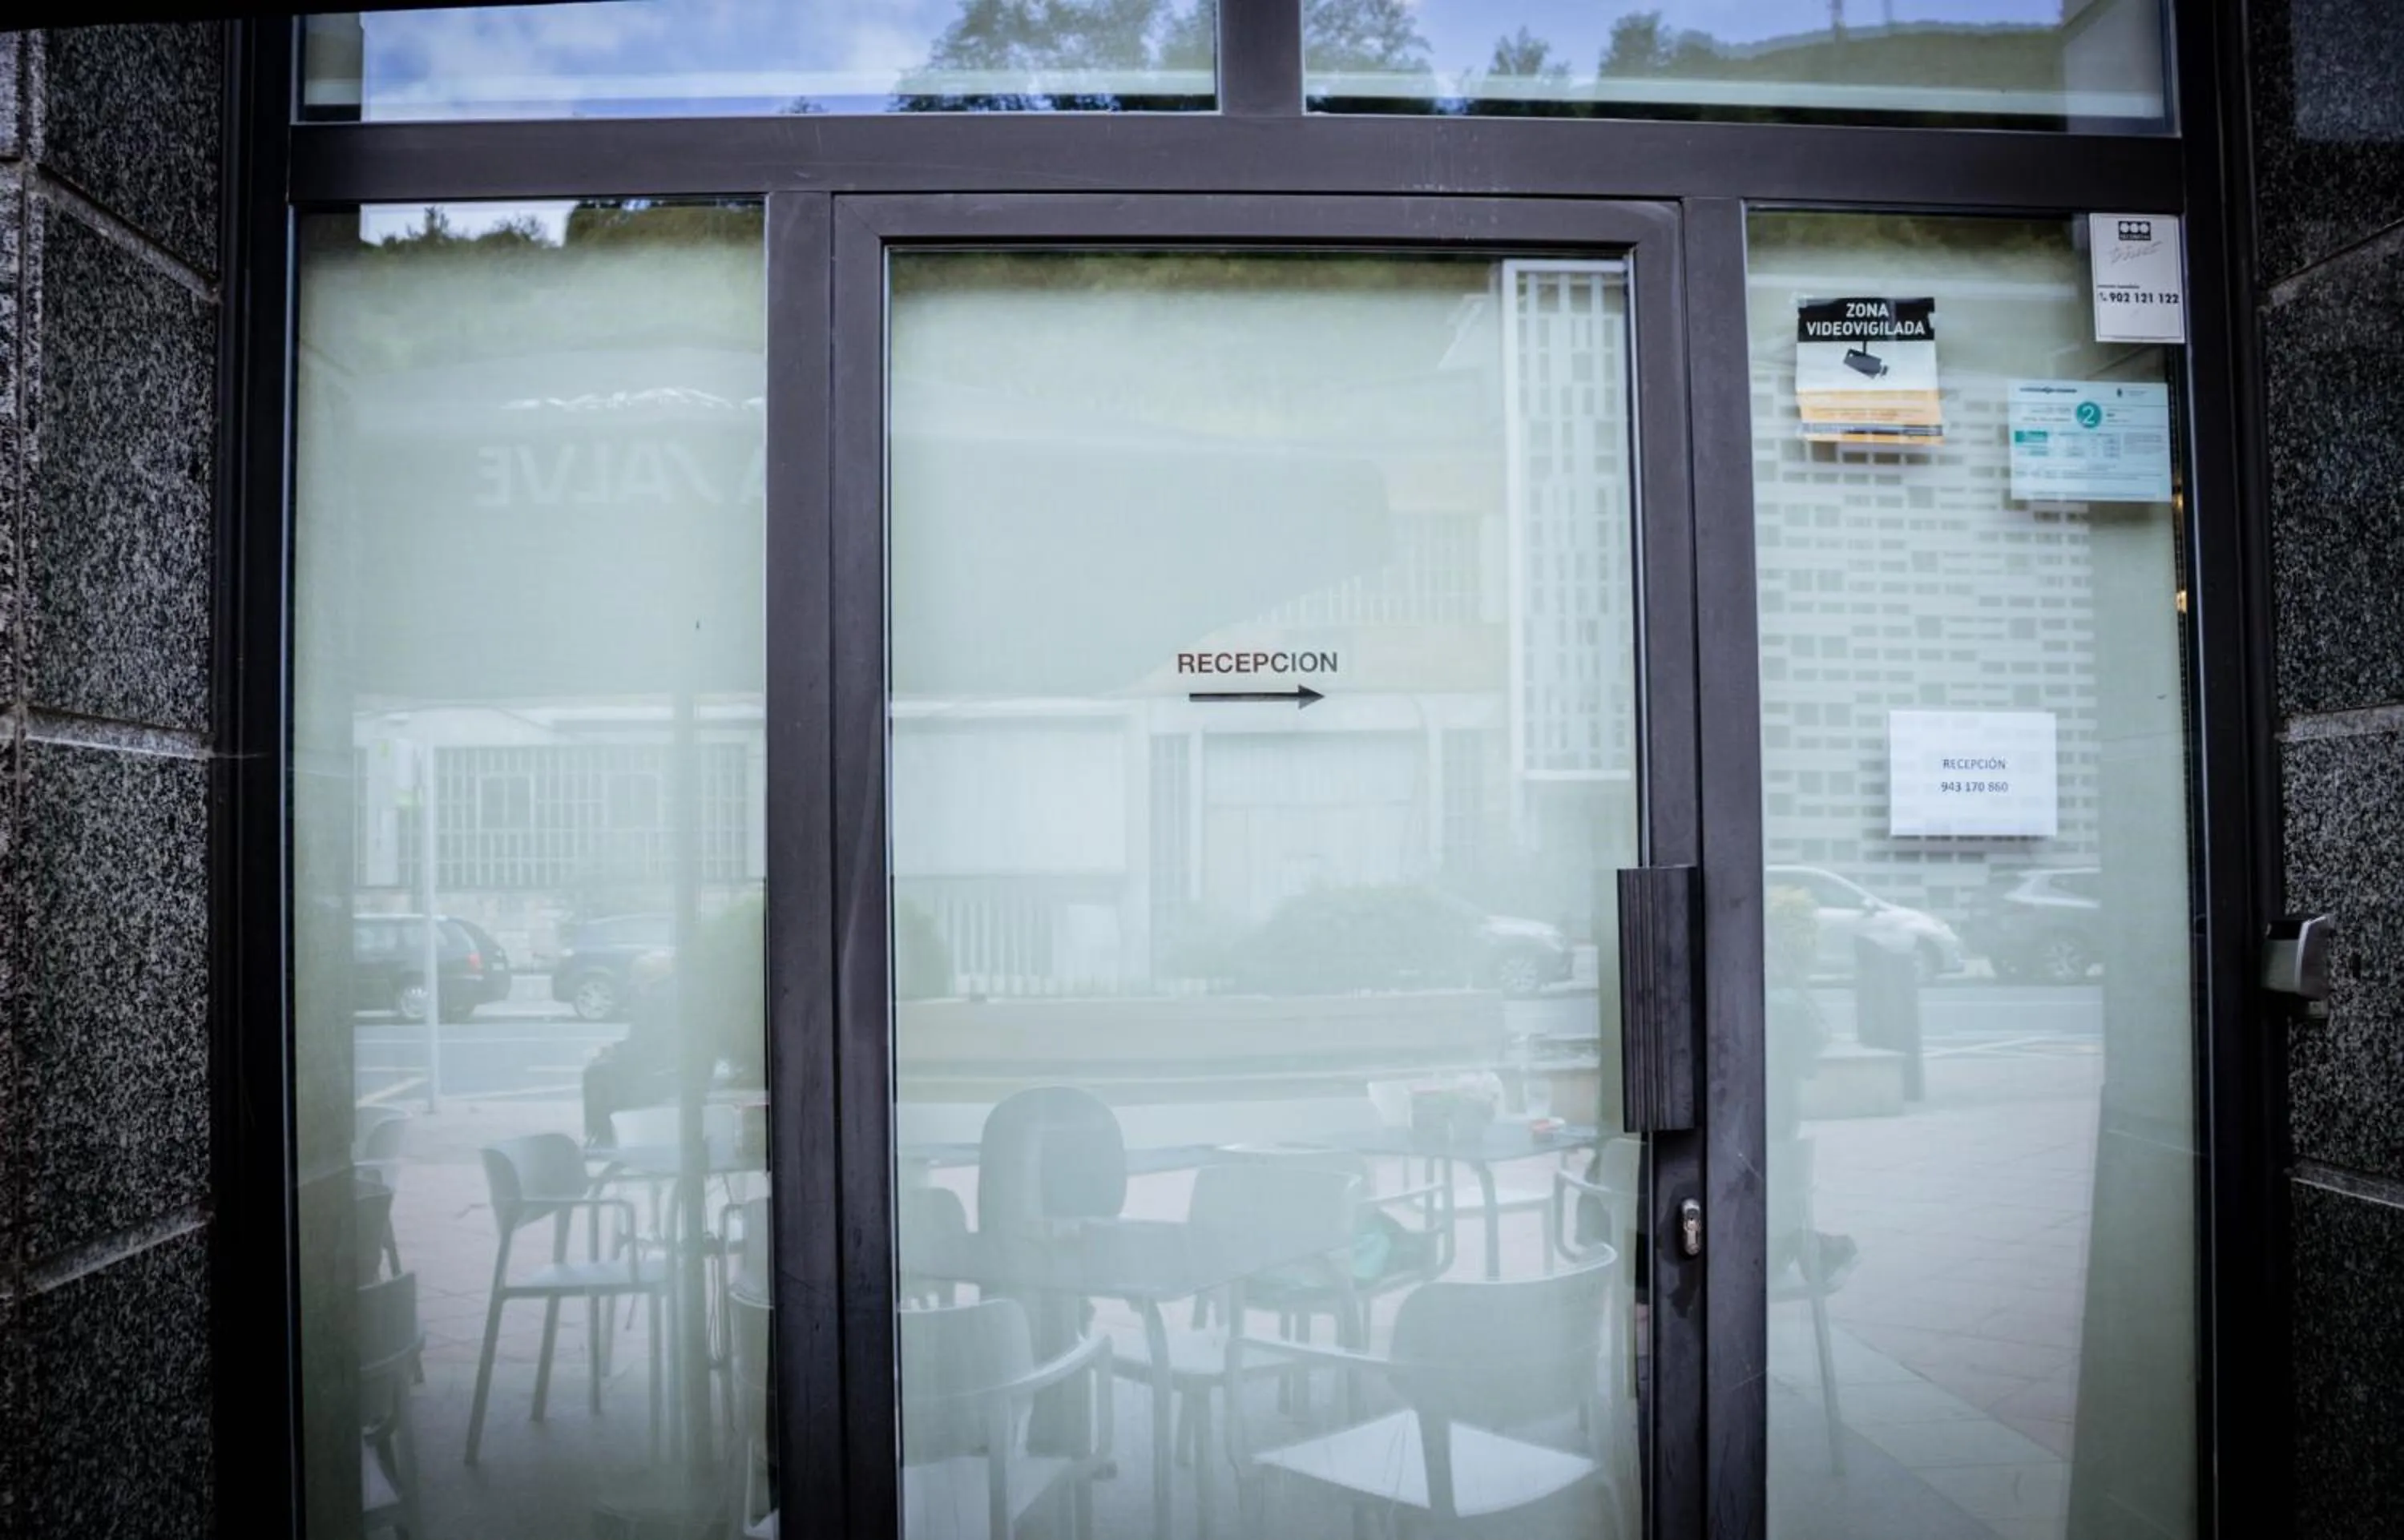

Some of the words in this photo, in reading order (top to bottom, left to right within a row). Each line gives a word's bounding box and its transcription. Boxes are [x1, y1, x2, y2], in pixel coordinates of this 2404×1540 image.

[2109, 292, 2130, 303] 902
[2159, 293, 2179, 304] 122
[1845, 302, 1890, 318] ZONA
[1806, 320, 1926, 337] VIDEOVIGILADA
[2082, 405, 2095, 425] 2
[1177, 651, 1337, 674] RECEPCION
[1942, 756, 2007, 770] RECEPCIÓN
[1941, 781, 1962, 792] 943
[1965, 781, 1985, 792] 170
